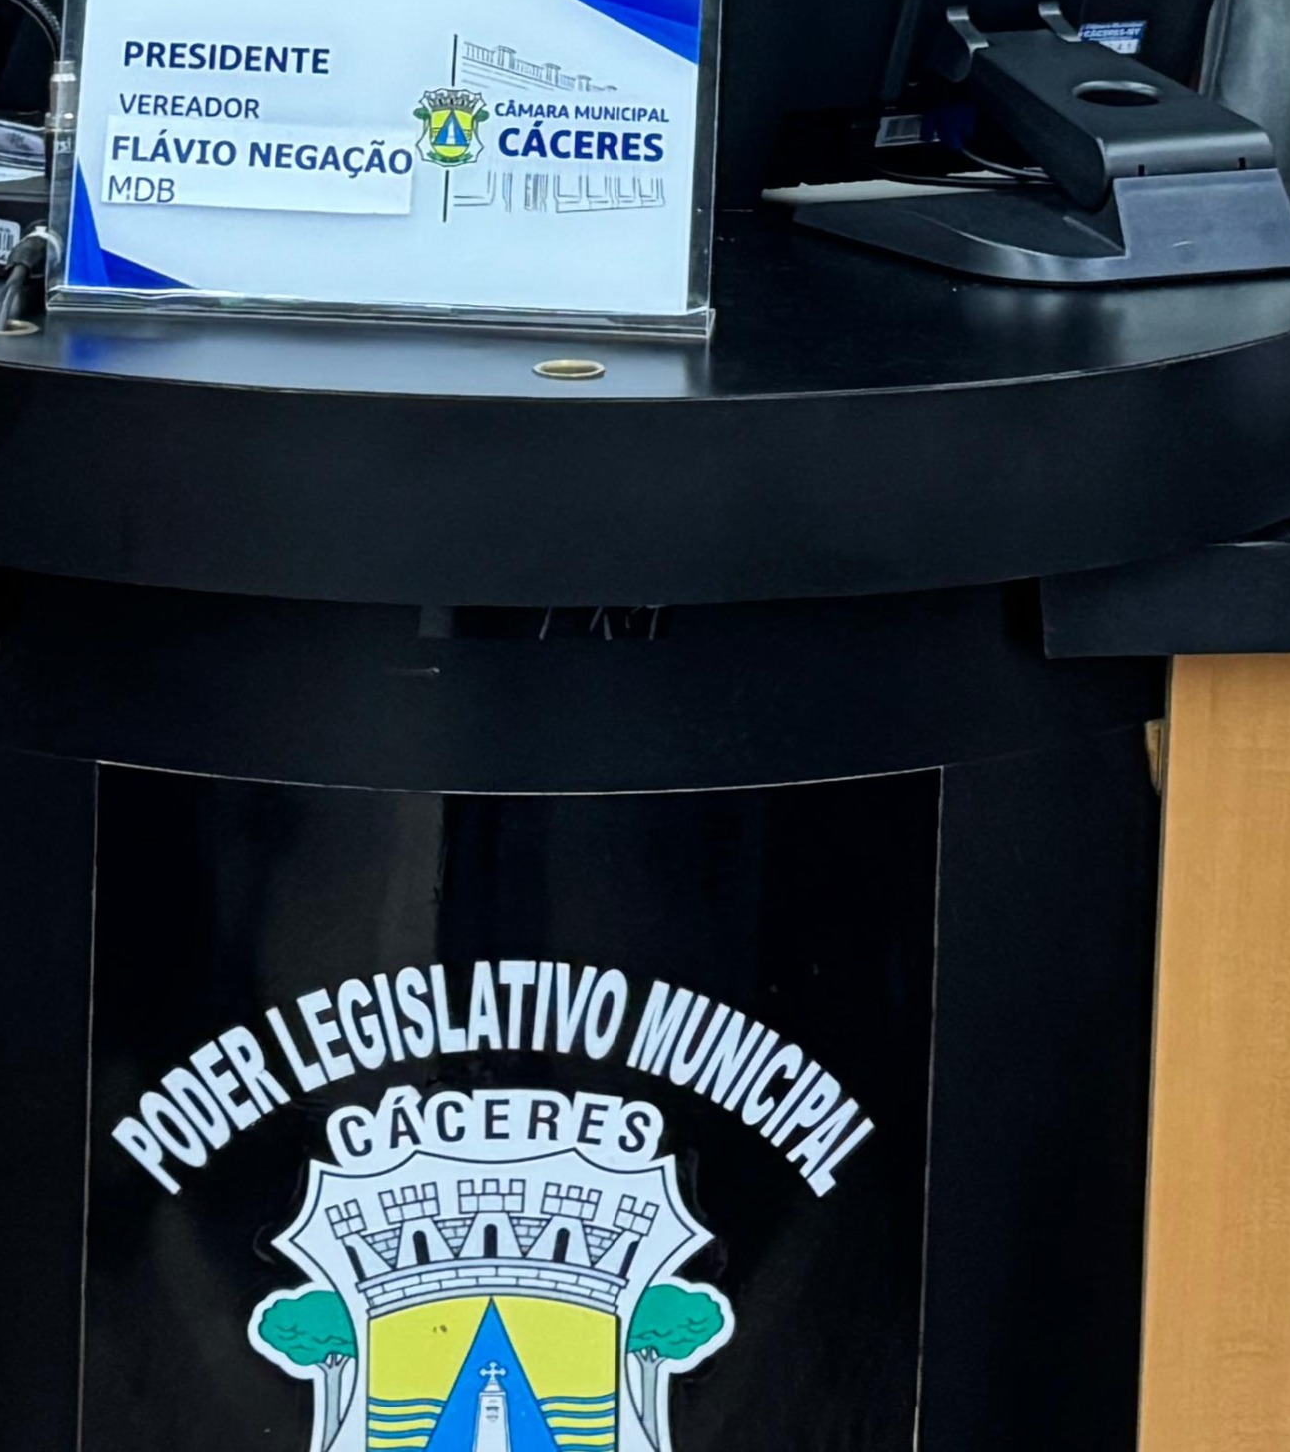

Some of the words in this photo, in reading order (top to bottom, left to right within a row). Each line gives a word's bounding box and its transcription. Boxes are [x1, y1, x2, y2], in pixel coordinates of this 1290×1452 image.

[124, 41, 329, 74] PRESIDENTE
[119, 93, 259, 118] VEREADOR
[494, 100, 569, 119] CÂMARA
[574, 105, 669, 123] MUNICIPAL
[111, 129, 236, 166] FLÁVIO
[248, 139, 413, 178] NEGAÇÃO
[498, 121, 664, 162] CÁCERES
[108, 175, 175, 203] MDB
[111, 1026, 289, 1195] PODER
[265, 960, 628, 1093] LEGISLATIVO
[626, 979, 874, 1198] MUNICIPAL
[339, 1095, 652, 1157] CÁCERES
